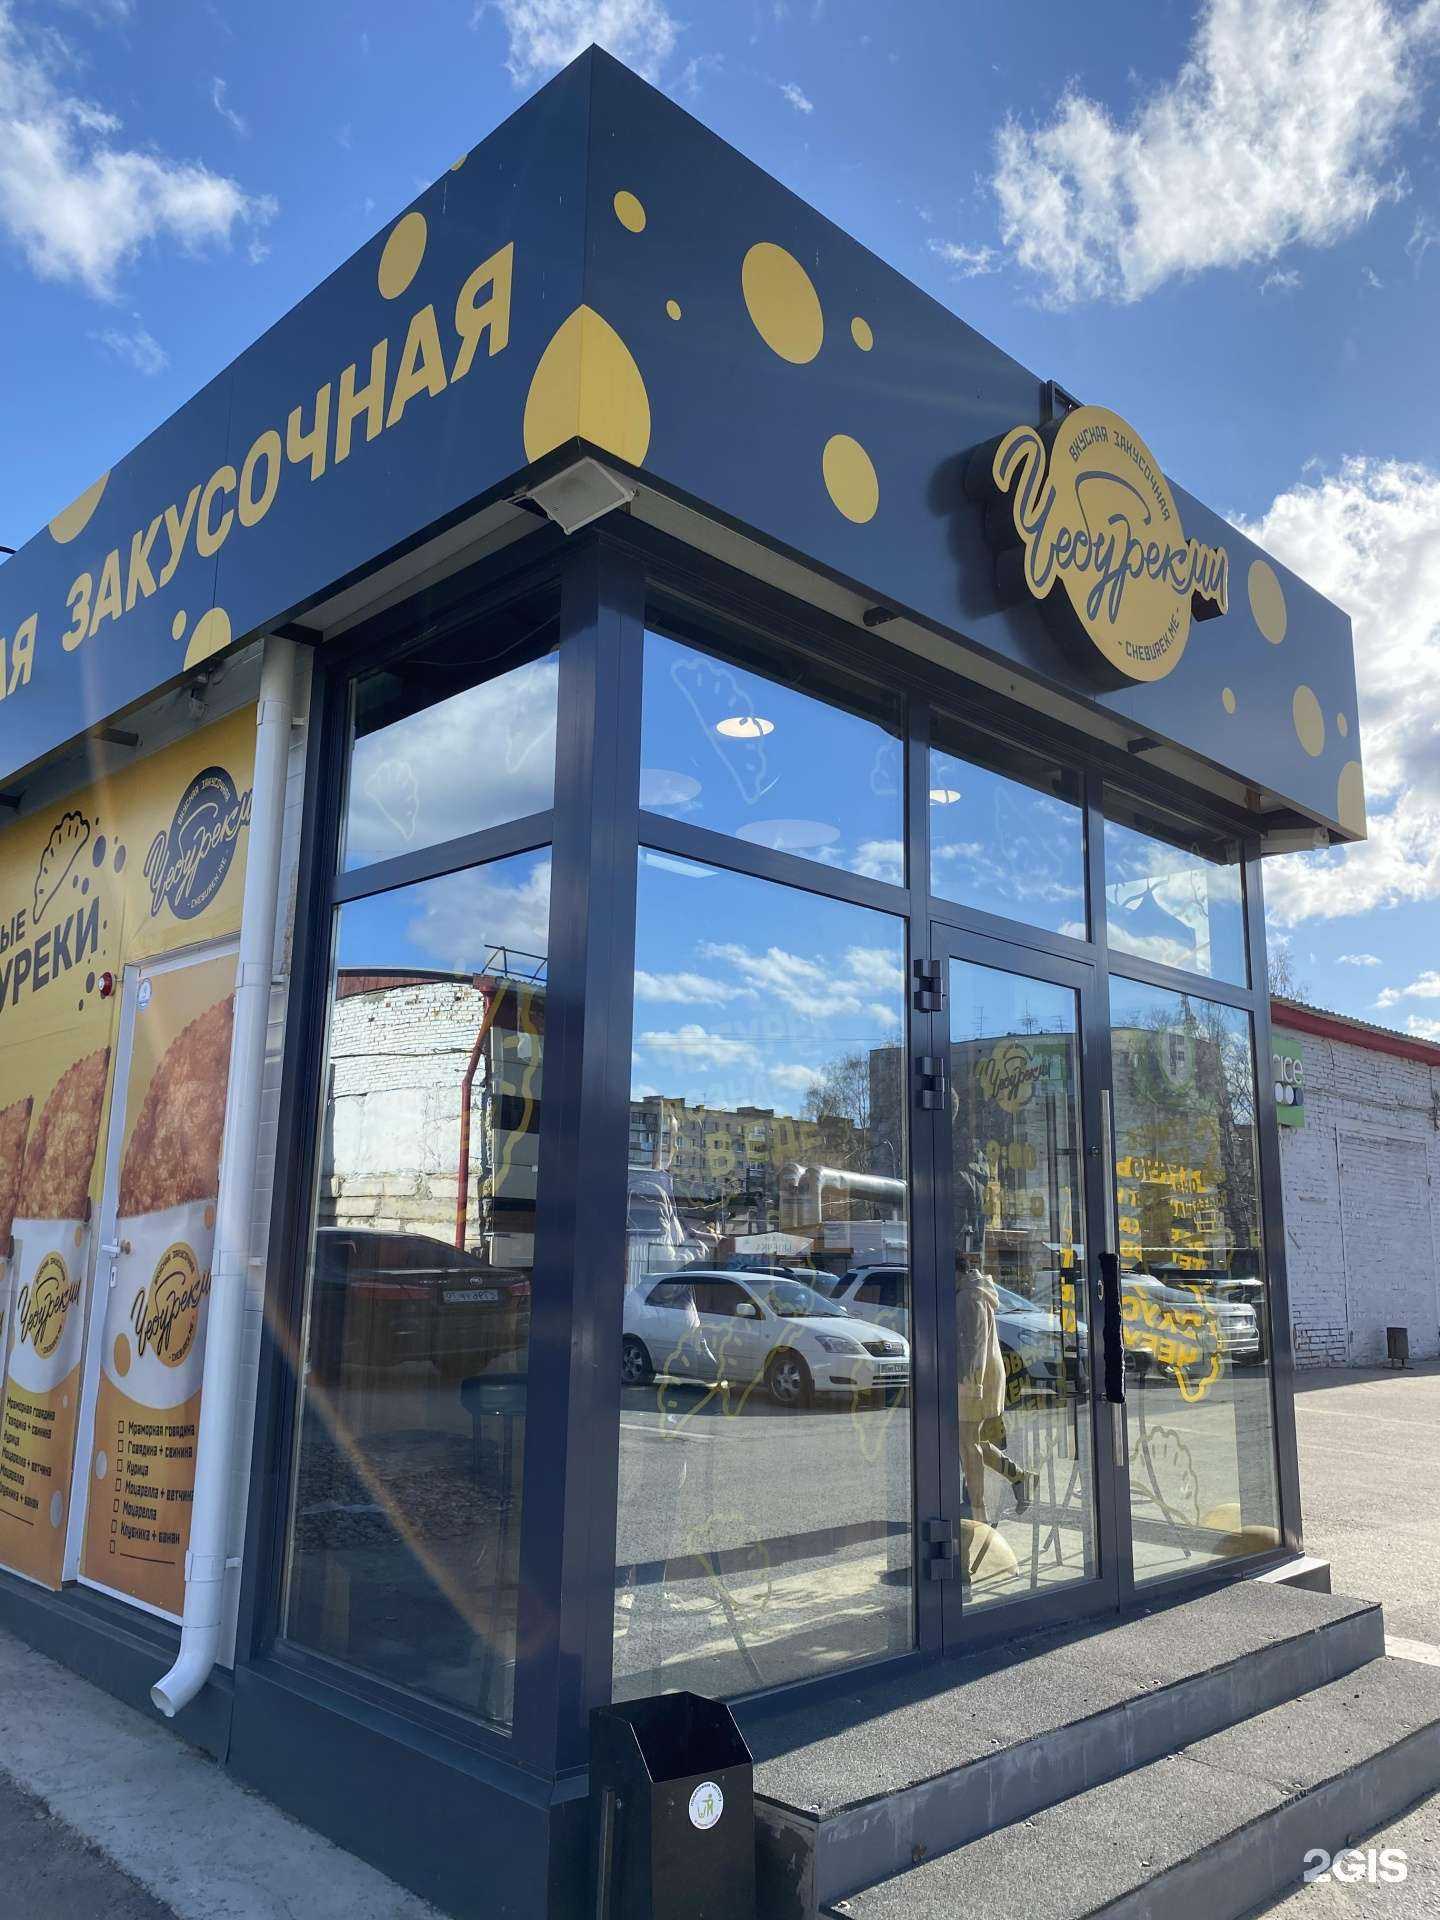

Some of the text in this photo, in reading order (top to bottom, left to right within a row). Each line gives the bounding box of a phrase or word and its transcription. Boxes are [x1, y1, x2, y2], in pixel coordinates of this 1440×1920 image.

[0, 241, 514, 700] Я ЗАКУСОЧНАЯ
[1068, 425, 1170, 521] ВКУСНАЯ ЗАКУСОЧНАЯ
